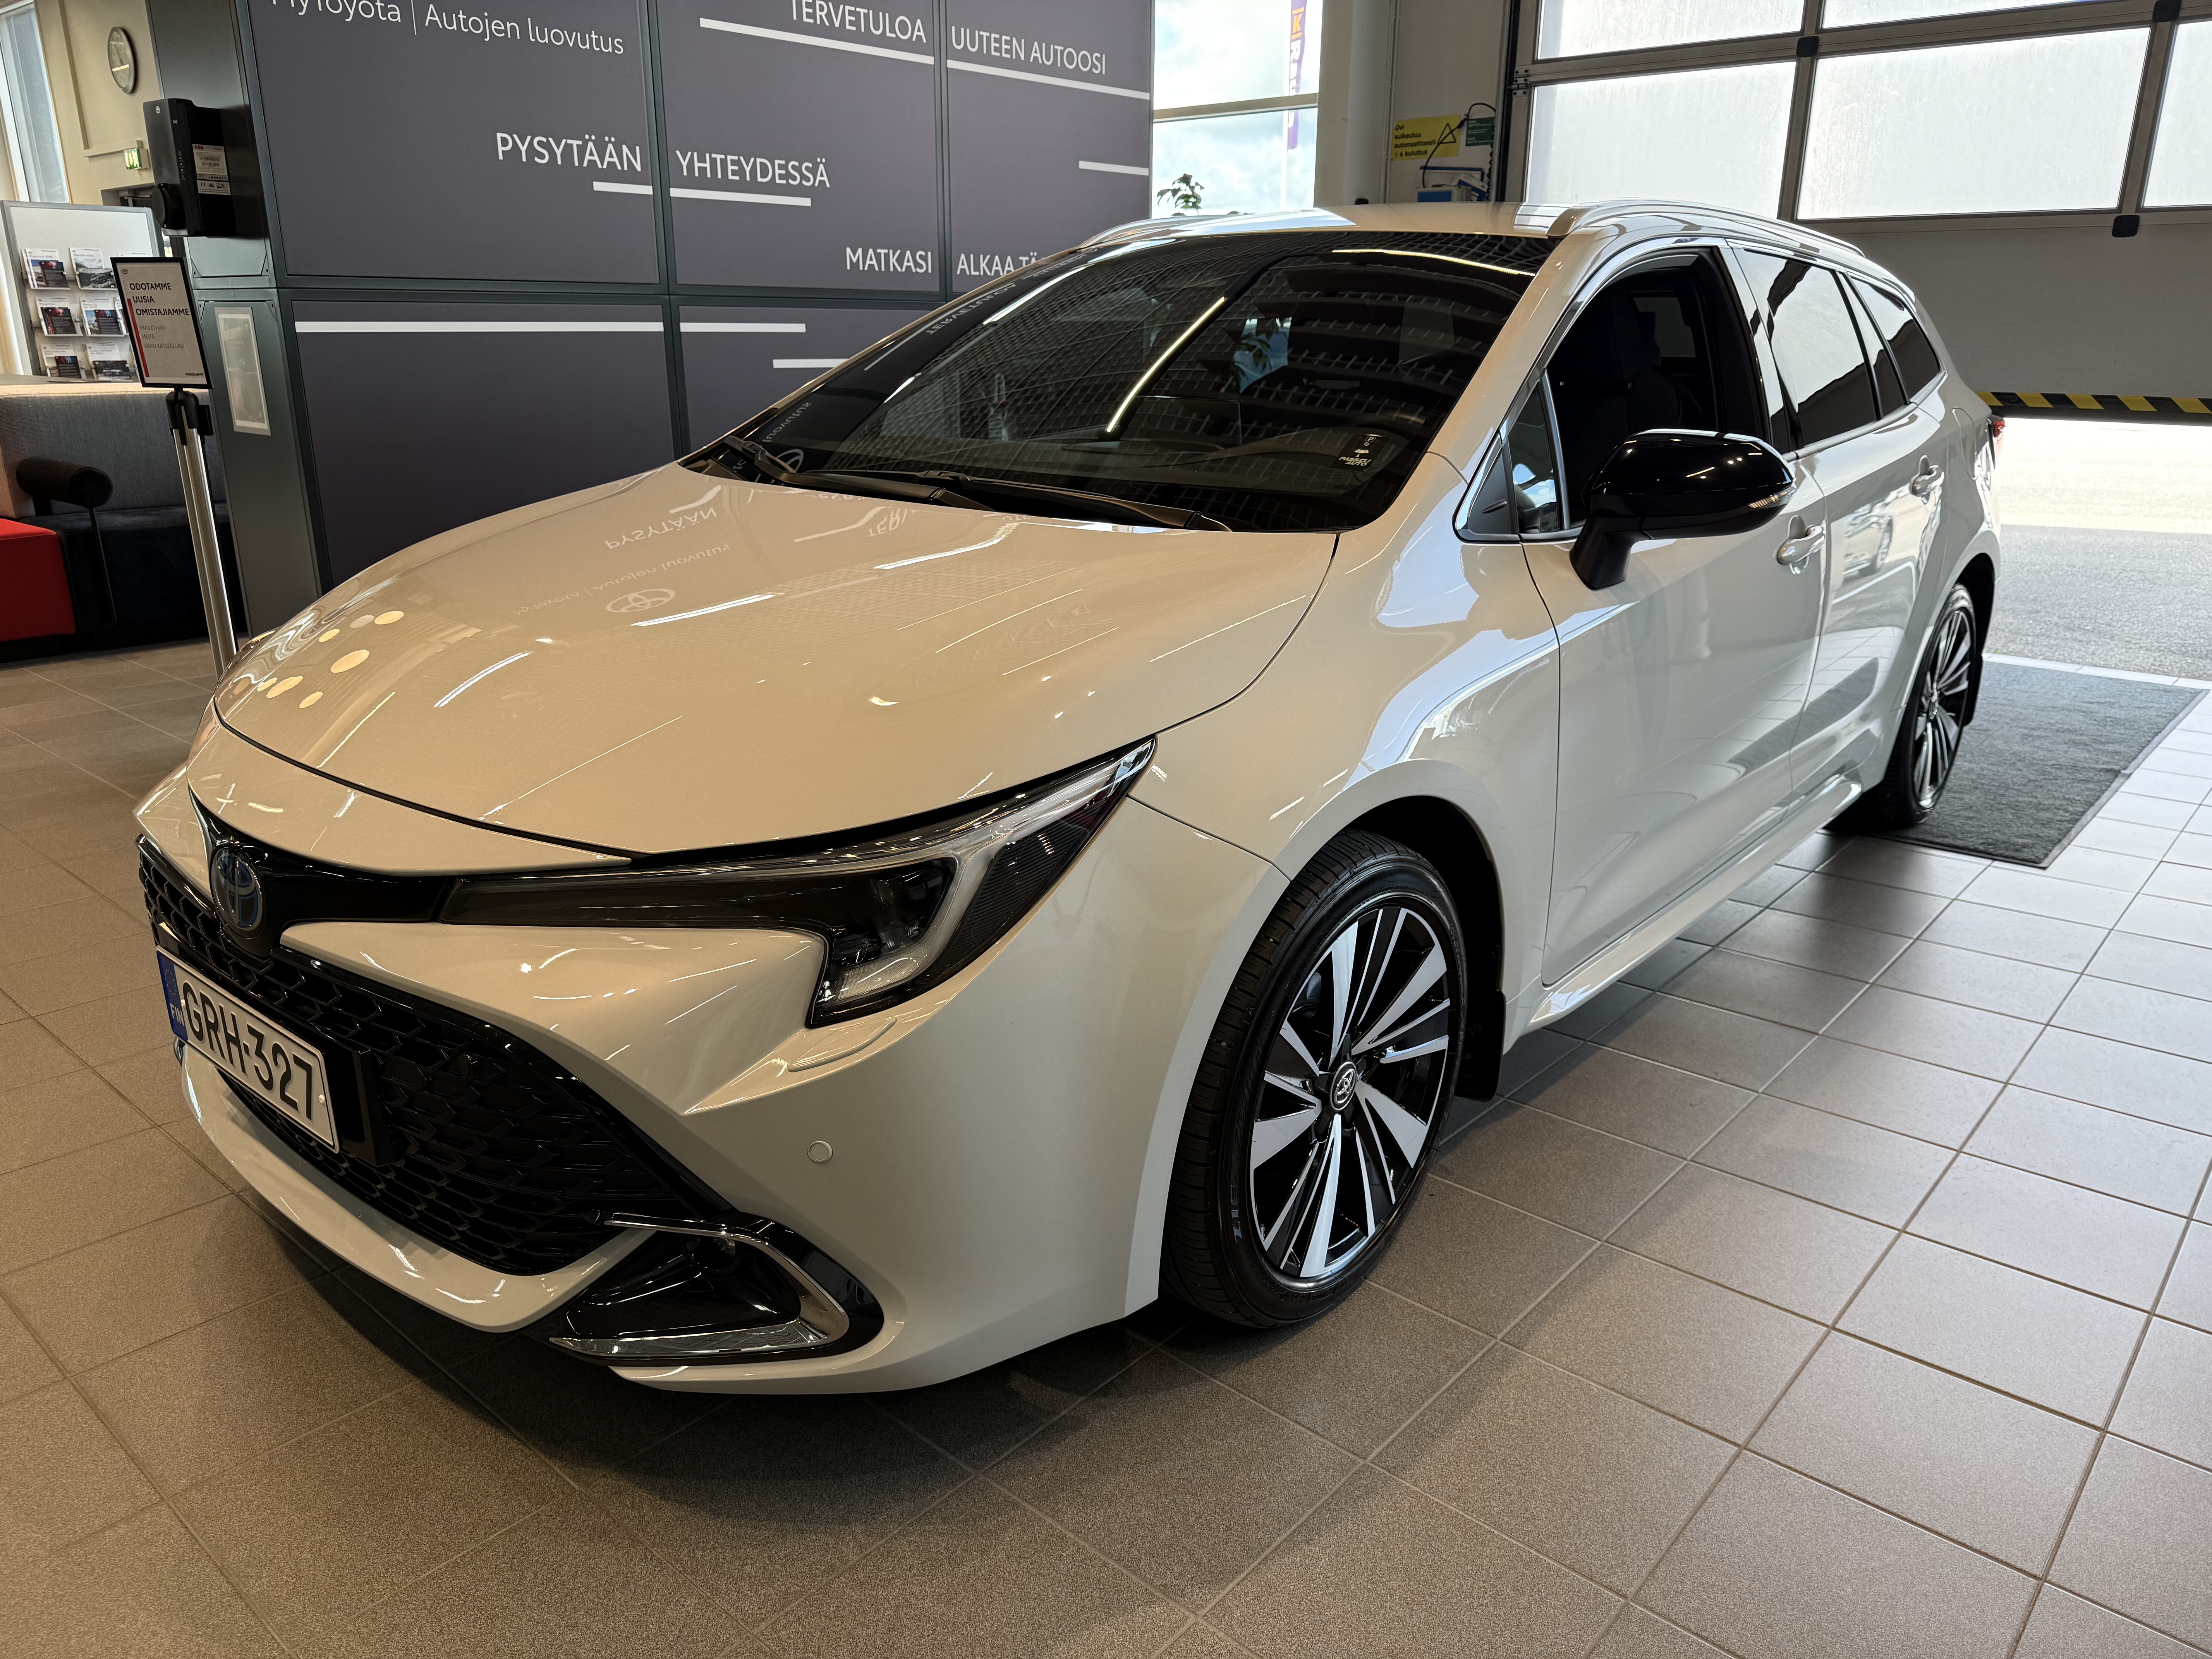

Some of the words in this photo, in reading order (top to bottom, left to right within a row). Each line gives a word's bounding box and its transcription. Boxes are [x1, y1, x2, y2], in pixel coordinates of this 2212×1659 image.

[425, 4, 520, 41] Autojen
[528, 18, 624, 54] luovutus
[792, 0, 926, 43] TERVETULOA
[952, 26, 1024, 60] UUTEEN
[1030, 41, 1105, 74] AUTOOSI
[496, 132, 641, 172] PYSYTÄÄN
[675, 150, 830, 187] YHTEYDESSÄ
[846, 247, 932, 273] MATKASI
[957, 253, 1015, 276] ALKAA
[170, 1003, 185, 1027] FIN
[183, 982, 313, 1121] GRH-327
